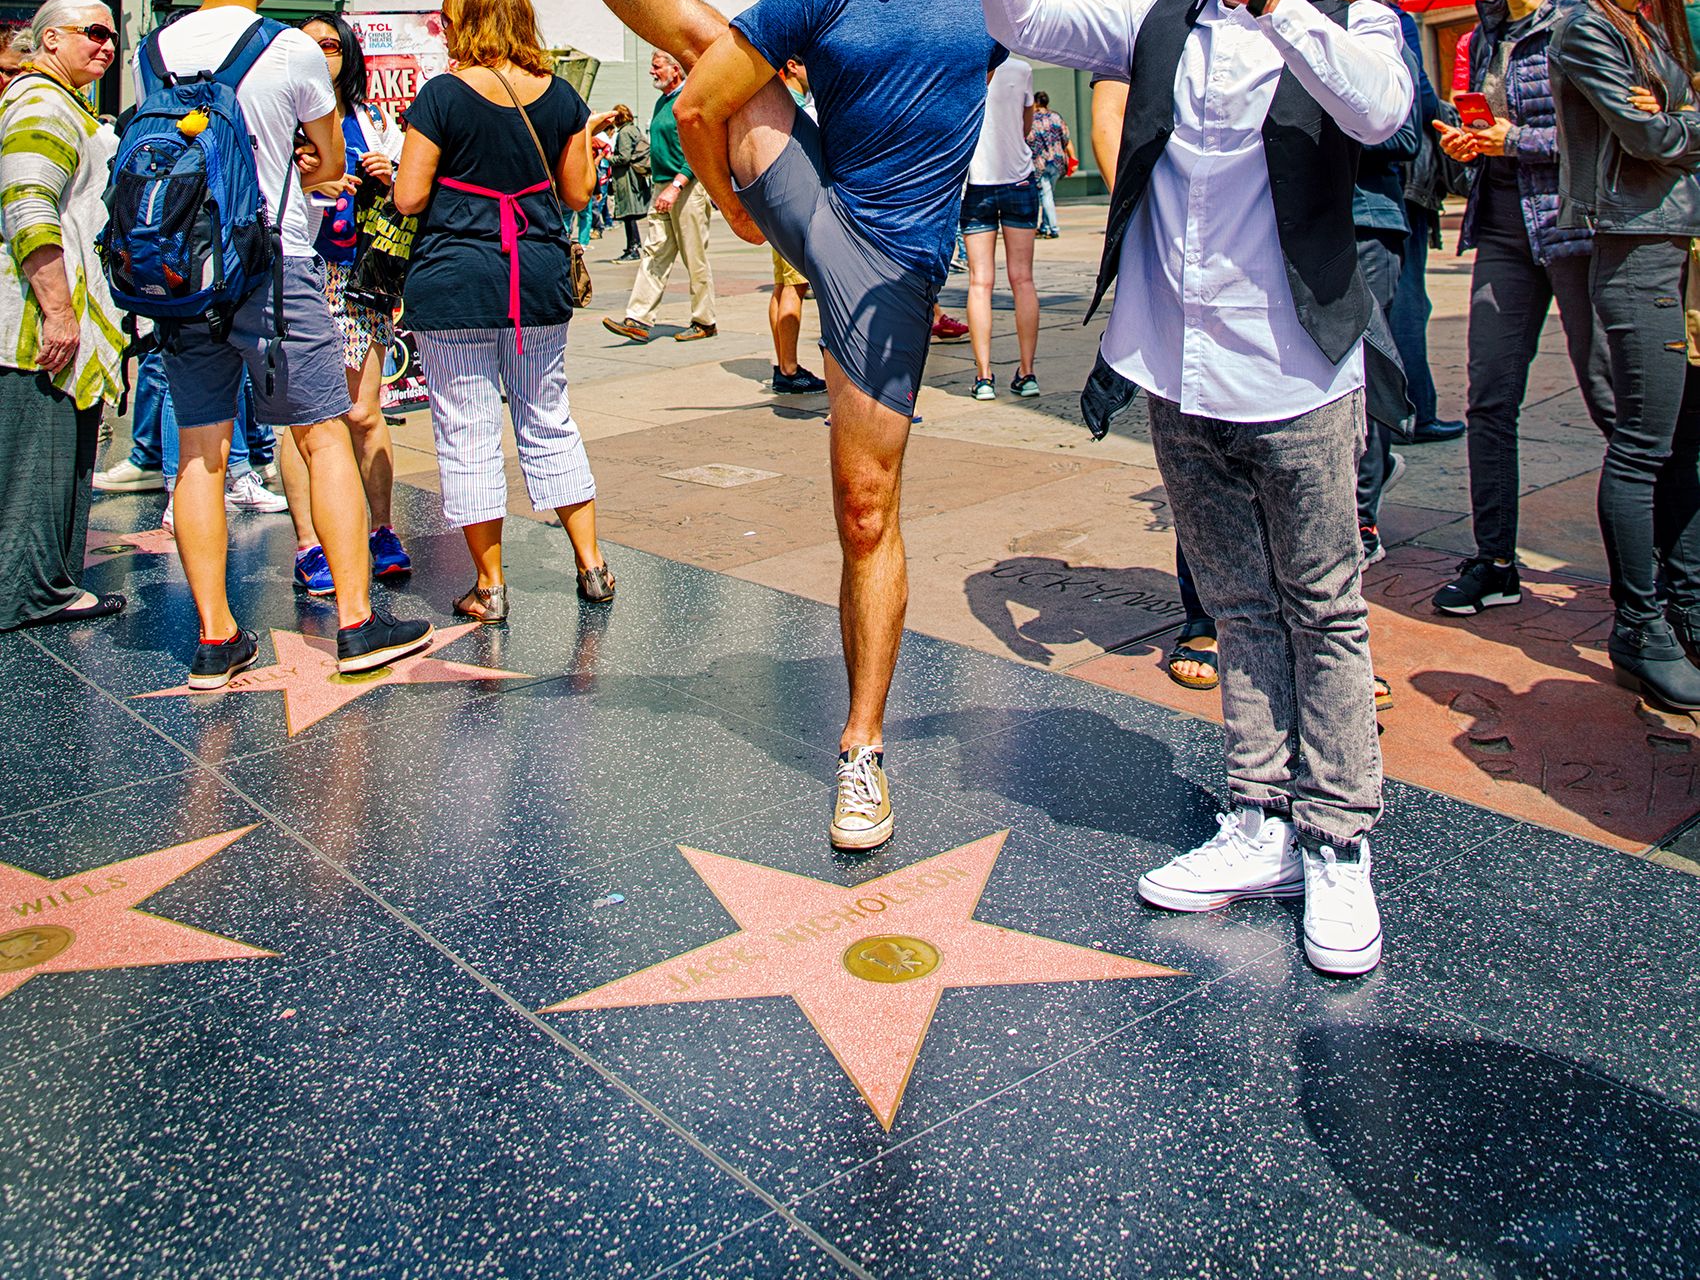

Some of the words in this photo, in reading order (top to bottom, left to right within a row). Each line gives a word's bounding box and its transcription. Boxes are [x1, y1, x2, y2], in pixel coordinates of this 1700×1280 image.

[368, 23, 392, 31] TCL
[366, 70, 415, 99] AKE
[227, 667, 297, 689] BILLY
[10, 874, 128, 917] WILLS
[664, 945, 769, 993] JACK
[772, 865, 972, 949] NICHOLSON
